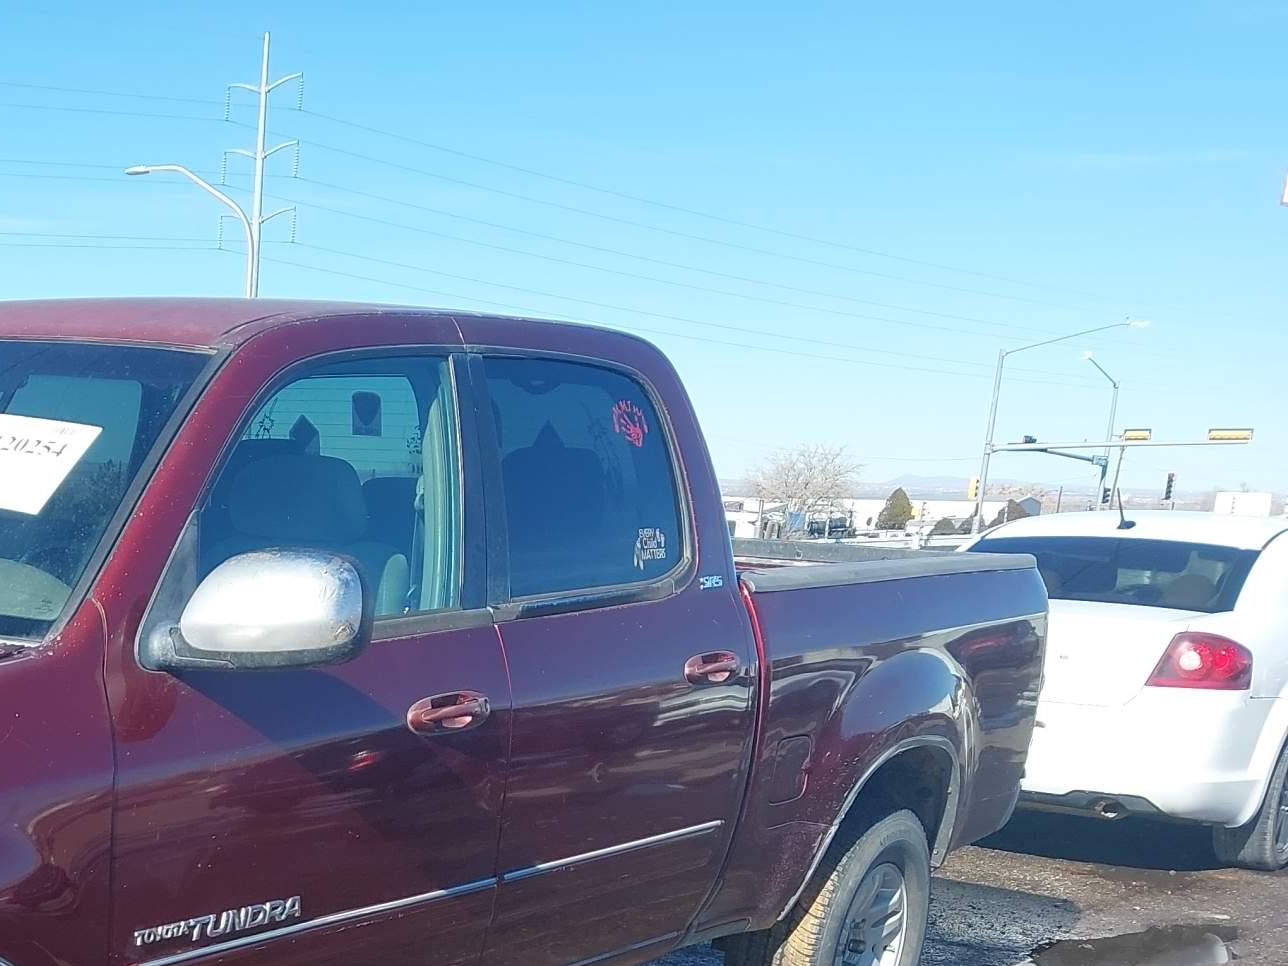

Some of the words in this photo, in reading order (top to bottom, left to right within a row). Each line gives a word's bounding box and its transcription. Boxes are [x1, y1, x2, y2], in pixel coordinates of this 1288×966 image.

[643, 536, 658, 549] Child
[641, 548, 666, 560] MATTERS
[134, 919, 191, 946] TOYOTA
[190, 895, 301, 942] TUNDRA
